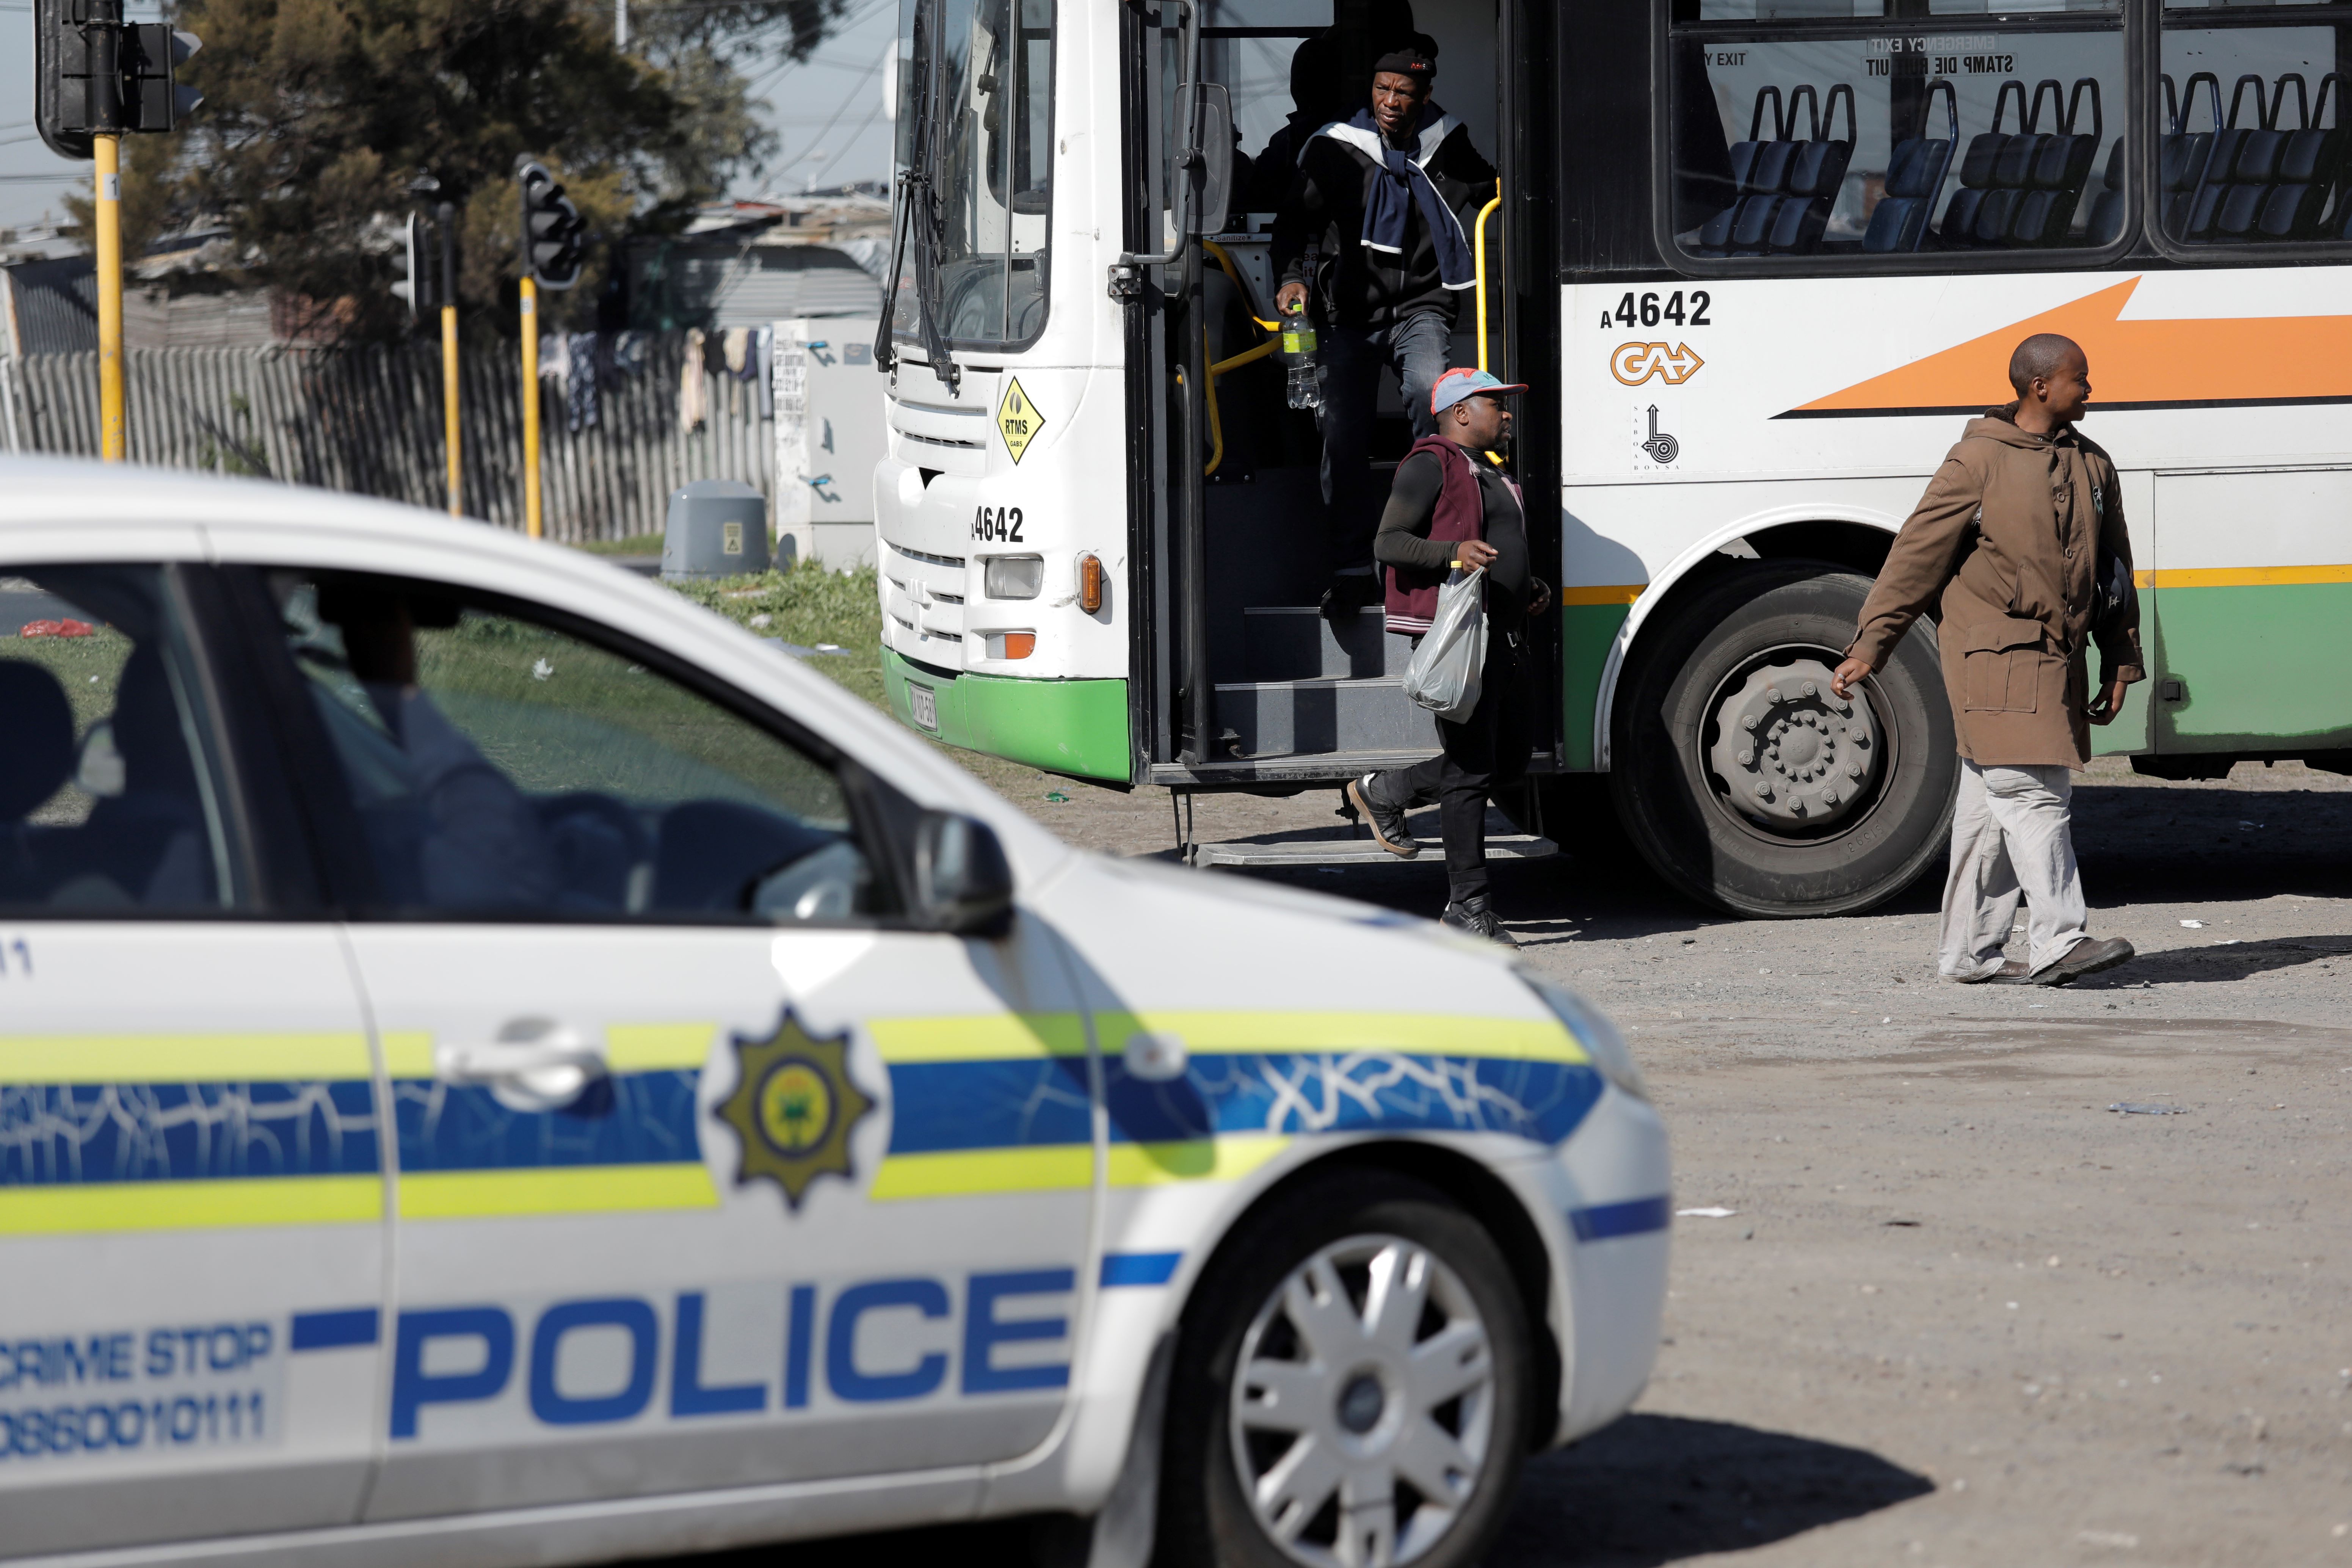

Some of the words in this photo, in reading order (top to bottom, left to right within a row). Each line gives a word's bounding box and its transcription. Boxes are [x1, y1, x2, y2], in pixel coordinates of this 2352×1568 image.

[1717, 53, 1746, 66] EXIT
[1005, 419, 1027, 435] RTMS
[147, 1322, 274, 1377] STOP
[389, 1267, 1077, 1440] POLICE
